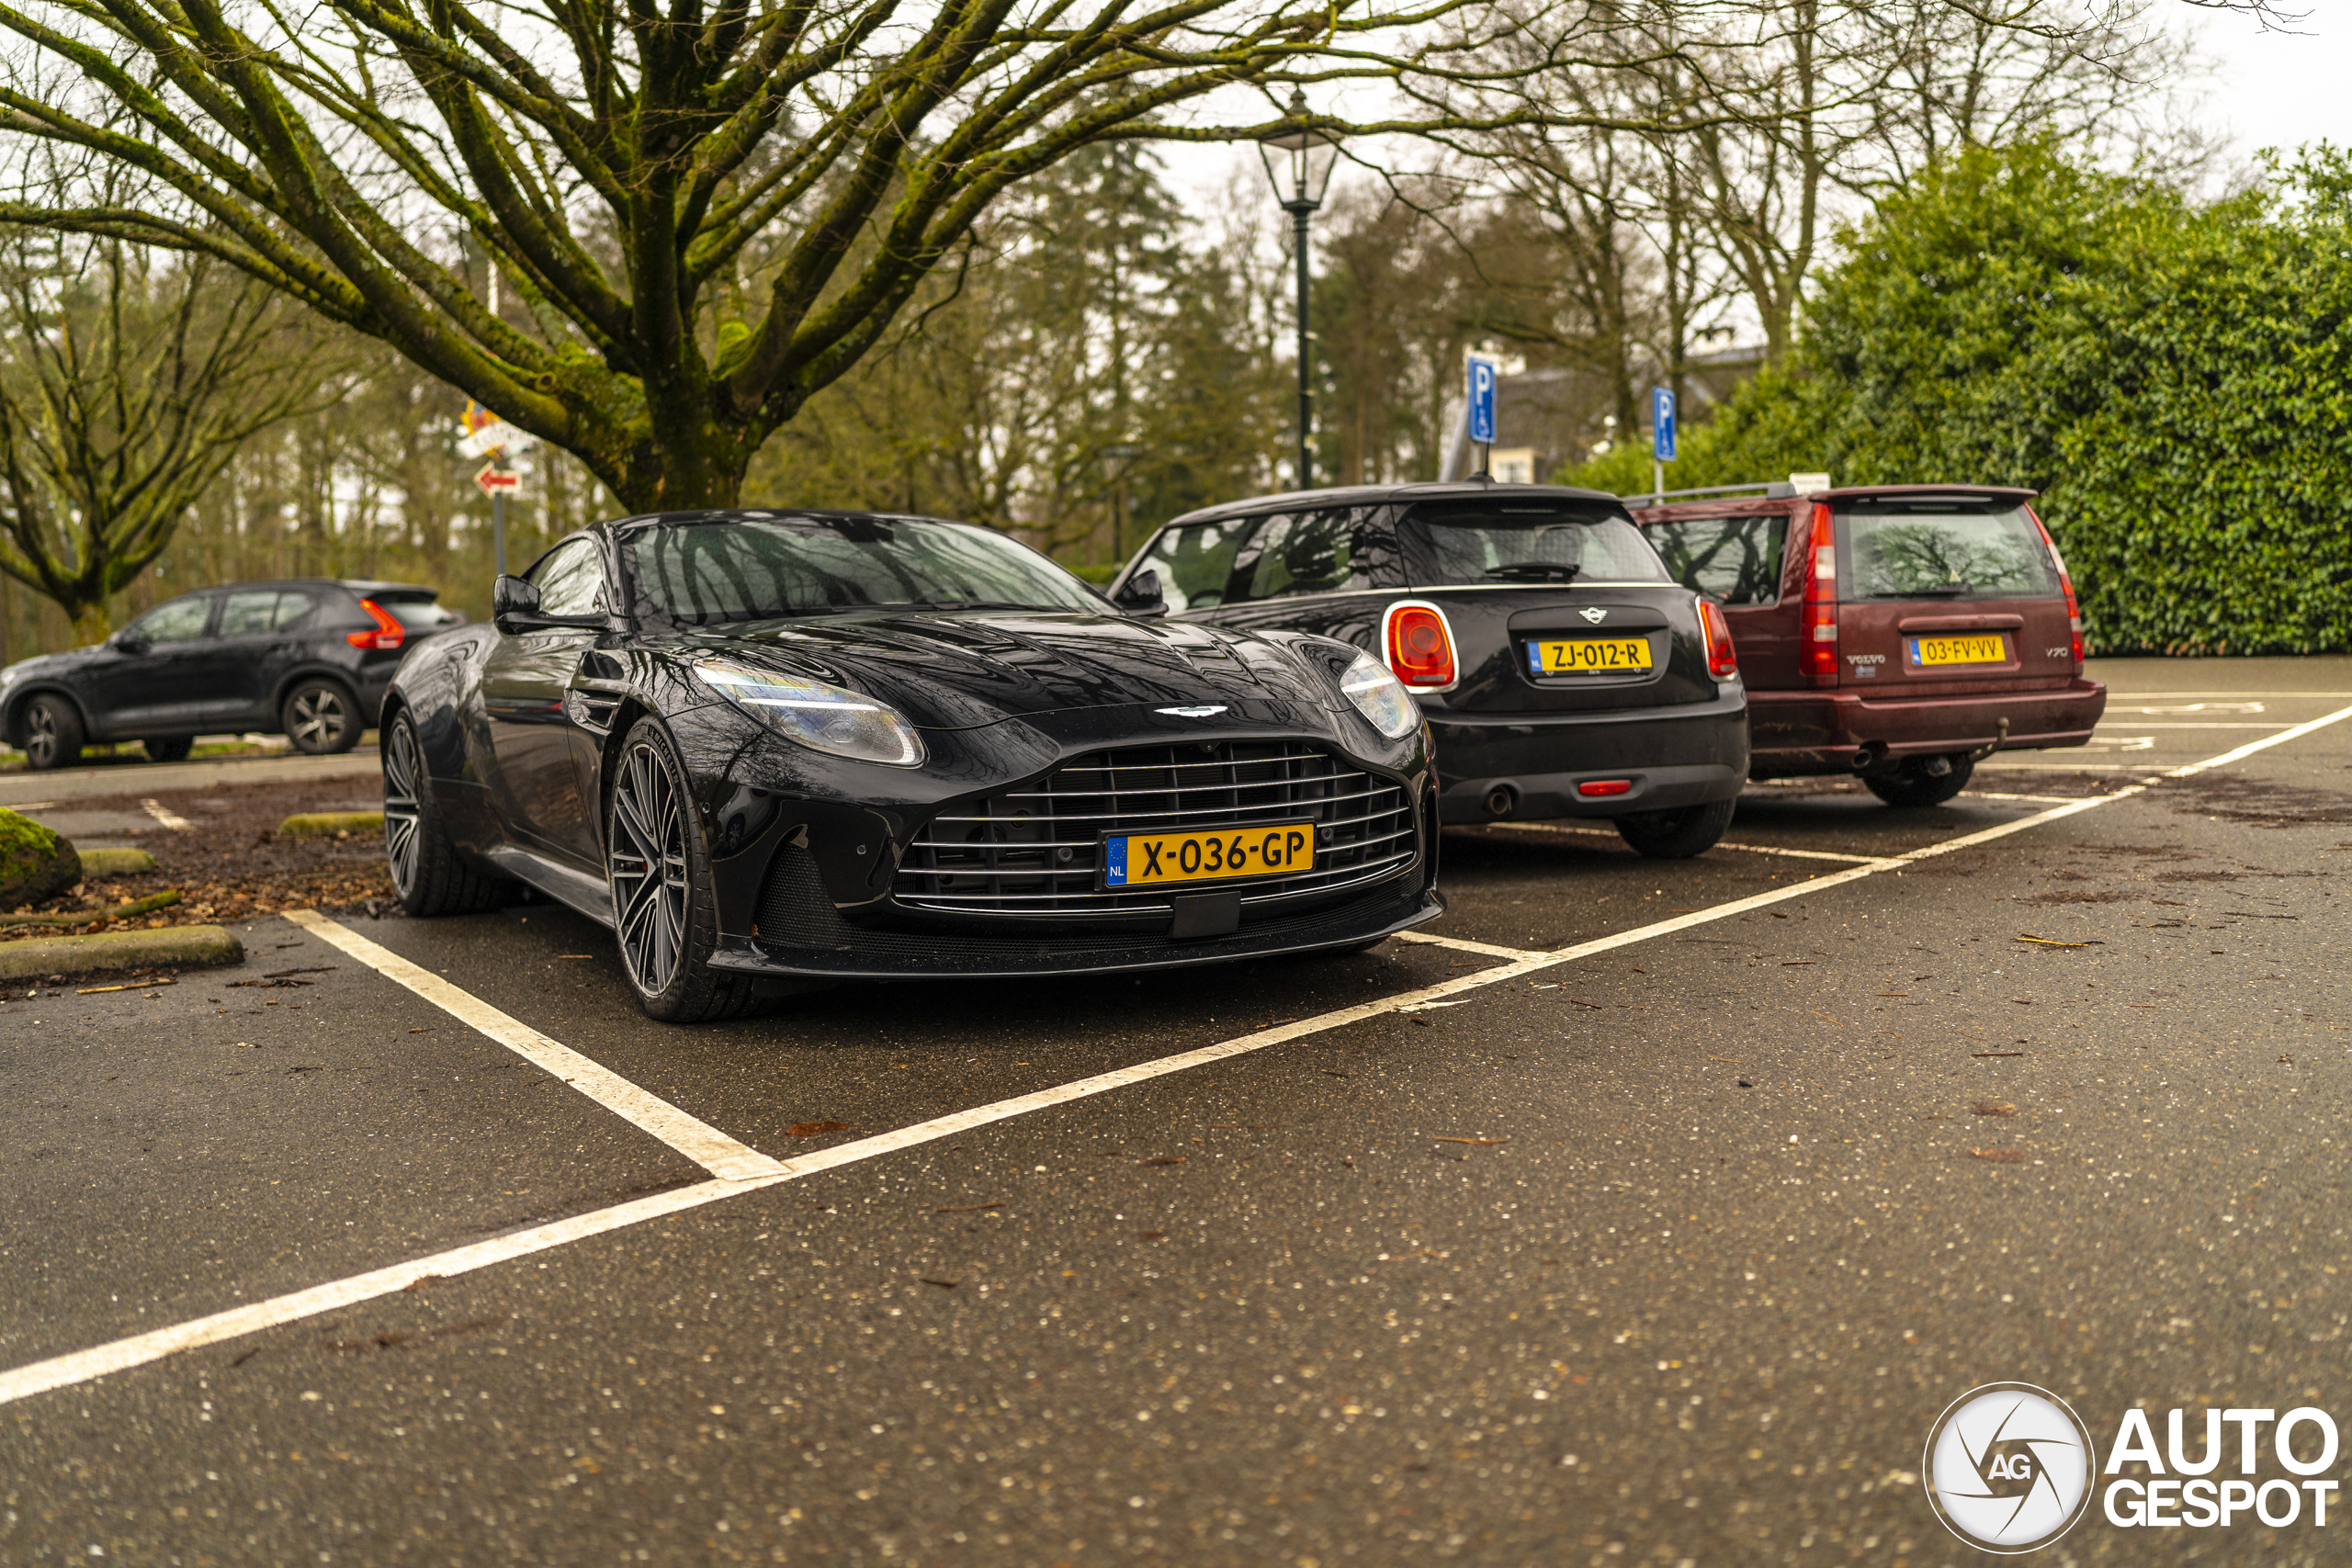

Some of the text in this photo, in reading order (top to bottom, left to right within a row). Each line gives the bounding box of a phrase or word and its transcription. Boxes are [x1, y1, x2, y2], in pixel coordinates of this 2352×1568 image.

[1476, 366, 1490, 405] P
[1659, 395, 1670, 429] P
[1553, 643, 1641, 668] ZJ-012-R
[1846, 654, 1886, 665] VOLVO
[1927, 639, 1996, 660] 03-FV-VV
[2044, 647, 2069, 659] V70
[1532, 660, 1541, 668] NL
[653, 733, 680, 784] MICHELIN
[1142, 831, 1305, 876] X-036-GP
[1110, 865, 1125, 877] NL
